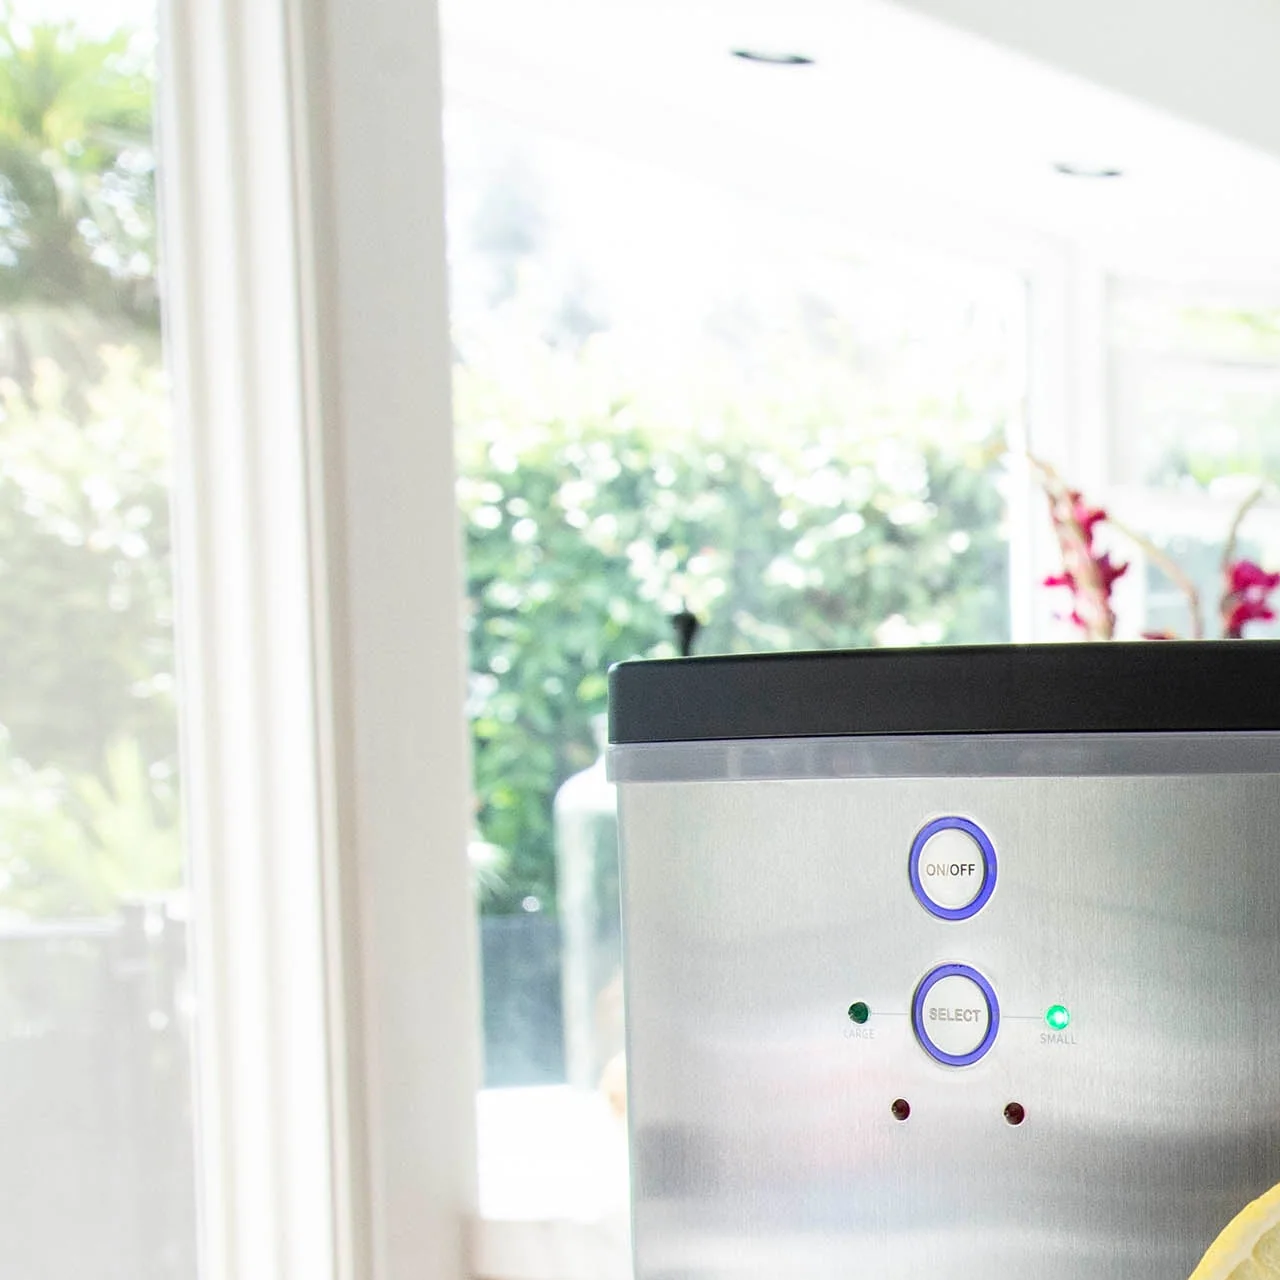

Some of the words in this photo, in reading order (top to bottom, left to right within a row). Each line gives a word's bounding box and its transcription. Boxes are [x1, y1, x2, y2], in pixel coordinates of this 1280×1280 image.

[926, 863, 976, 876] ON/OFF
[929, 1007, 982, 1022] SELECT
[843, 1027, 876, 1039] LARGE
[1040, 1032, 1077, 1045] SMALL
